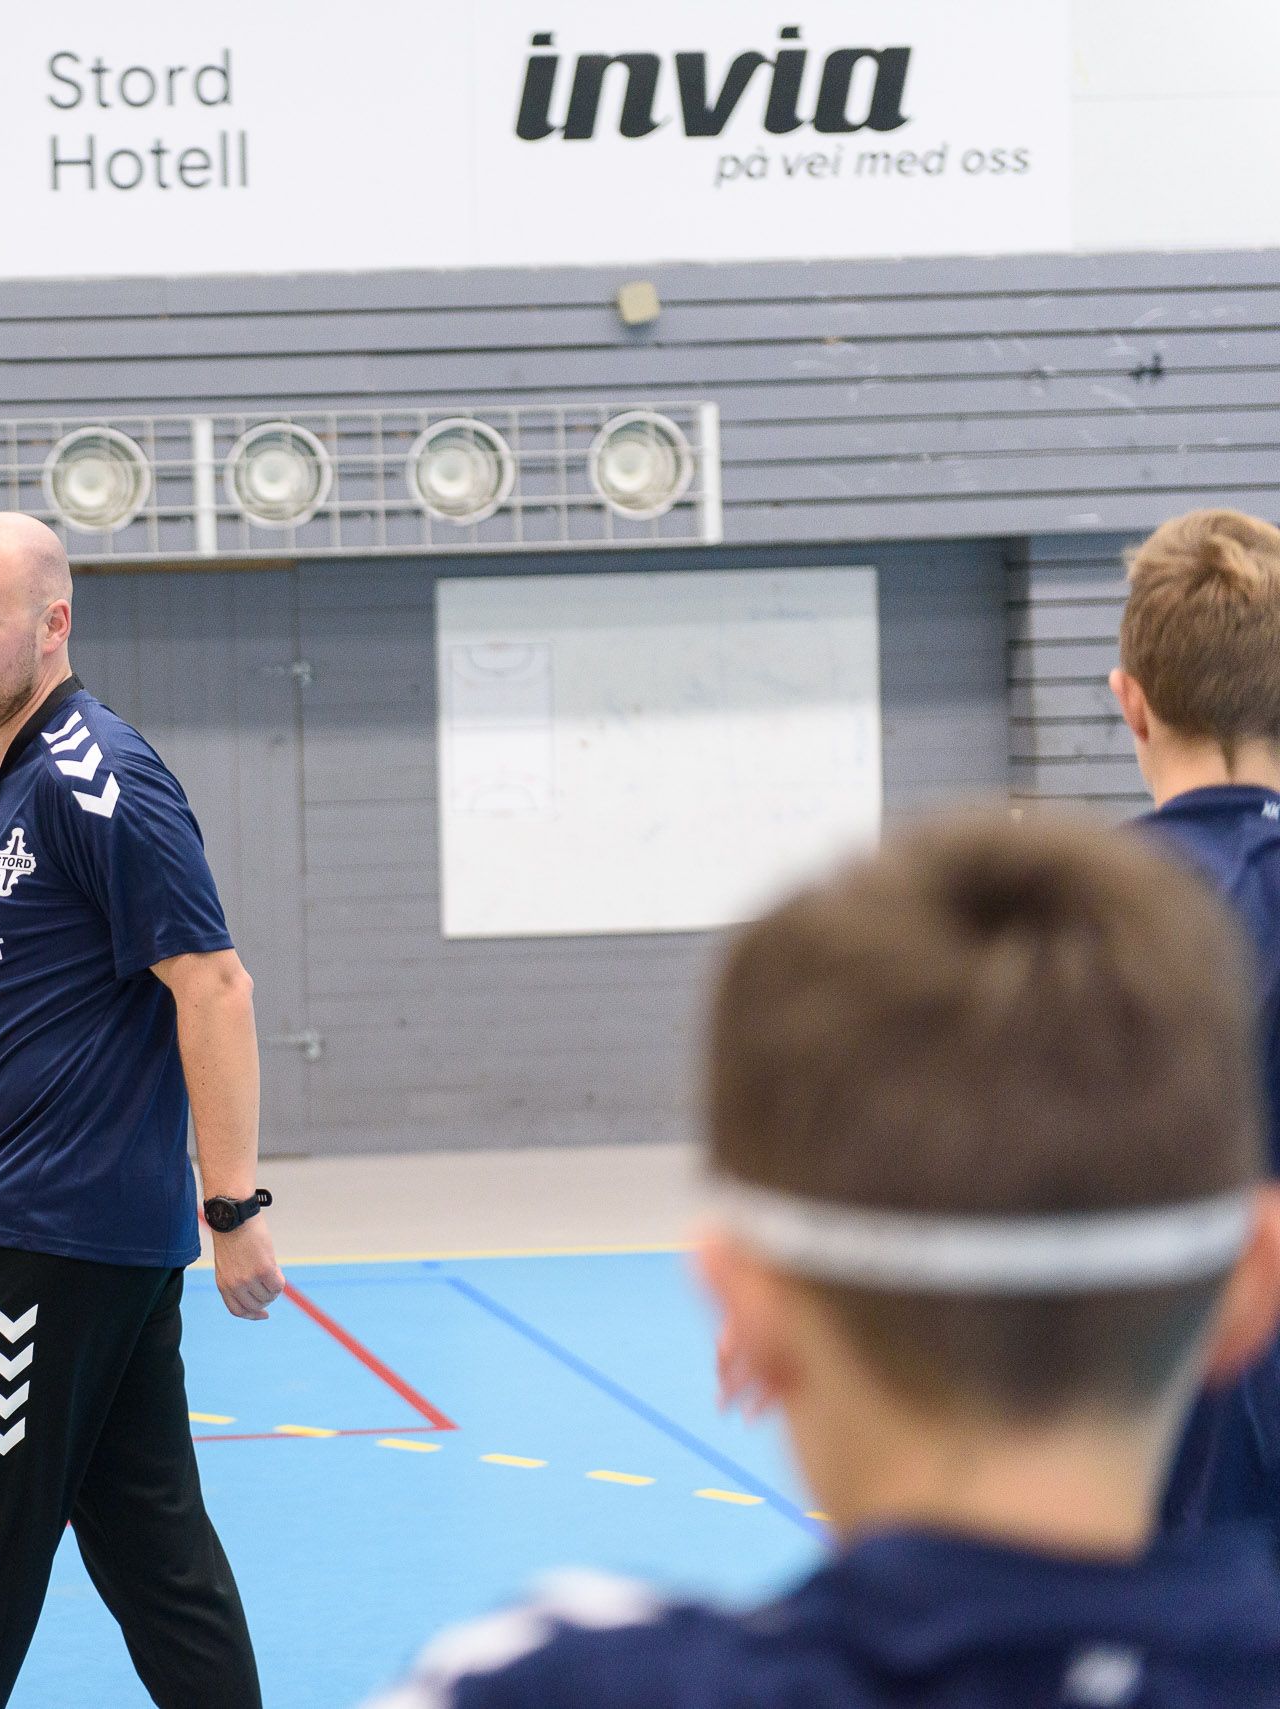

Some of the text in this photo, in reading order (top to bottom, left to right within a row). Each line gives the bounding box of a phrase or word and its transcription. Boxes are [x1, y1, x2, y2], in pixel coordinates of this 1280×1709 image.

[47, 48, 232, 109] Stord
[516, 26, 912, 141] invia
[50, 130, 248, 190] Hotell
[714, 141, 1032, 188] på vei med oss
